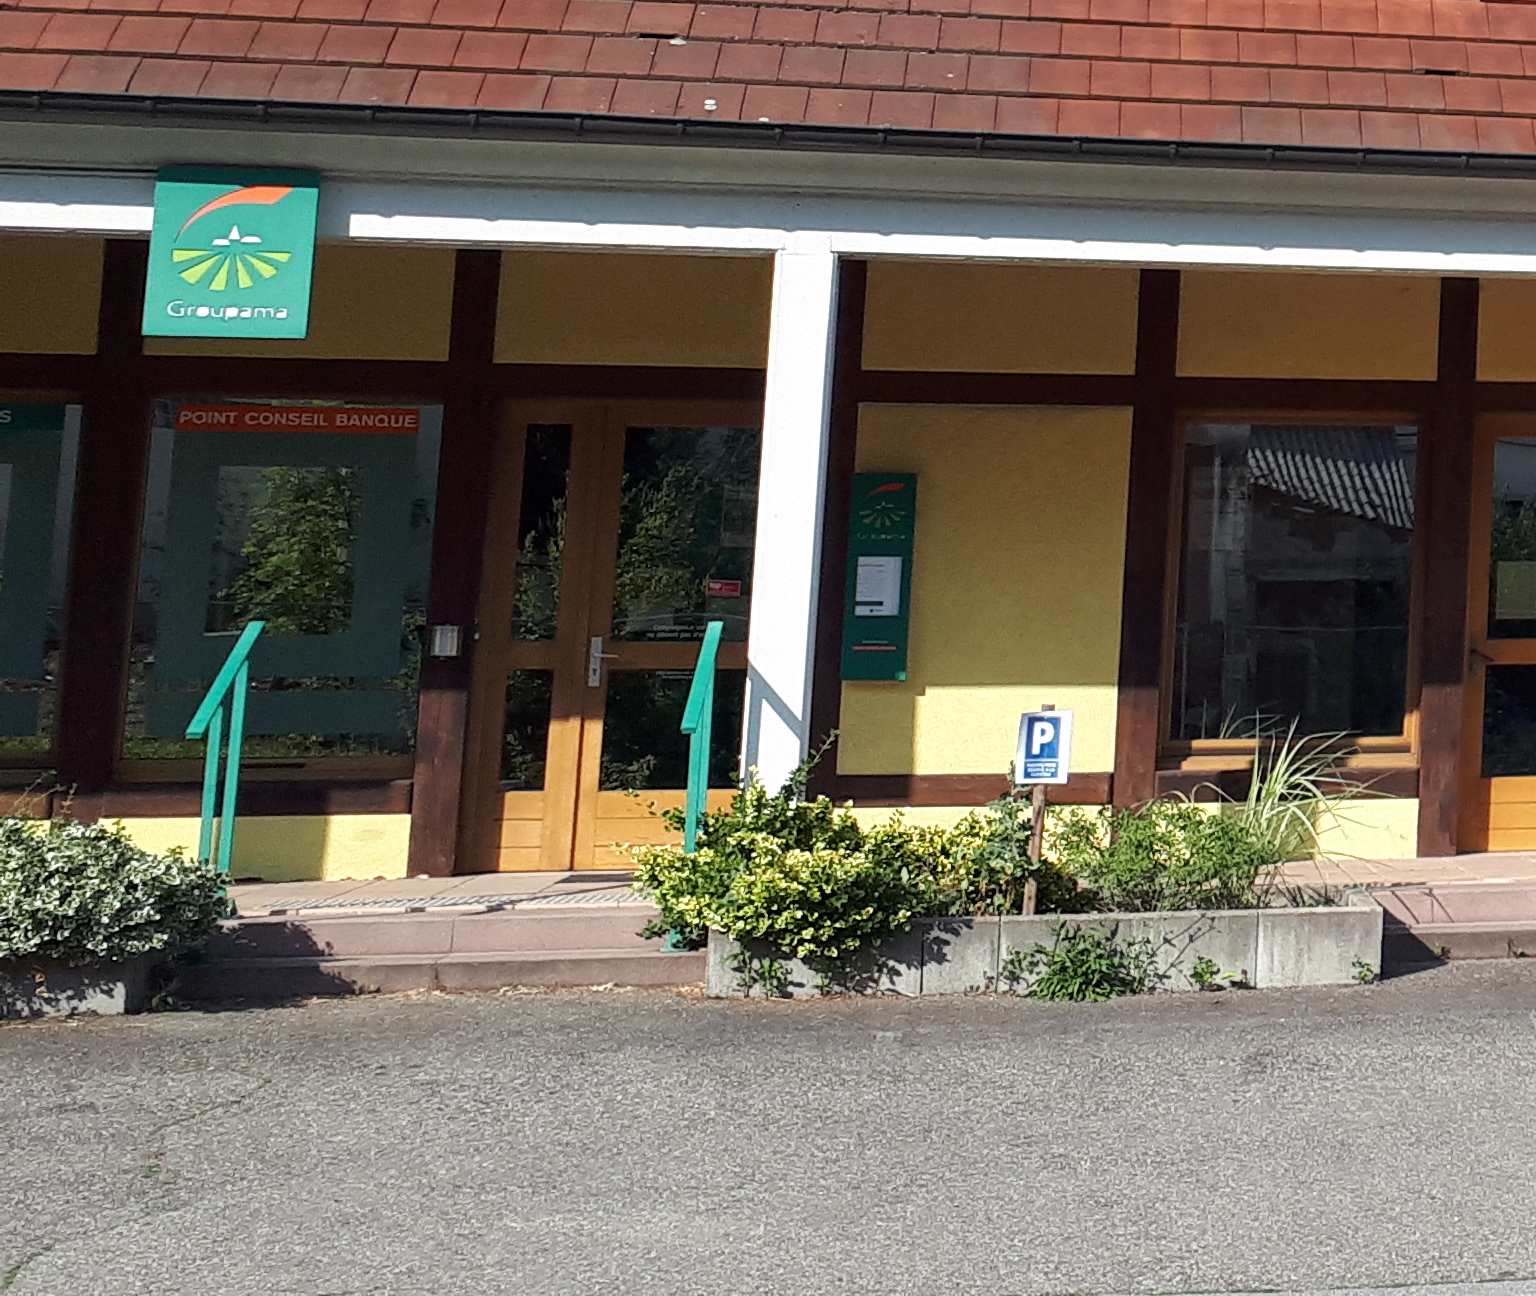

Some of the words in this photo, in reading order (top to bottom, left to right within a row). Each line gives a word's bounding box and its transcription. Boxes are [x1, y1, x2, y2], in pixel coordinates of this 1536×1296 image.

[166, 300, 288, 321] Groupama
[179, 410, 239, 425] POINT
[244, 411, 328, 427] CONSEIL
[335, 413, 417, 429] BANQUE
[1031, 721, 1055, 755] P
